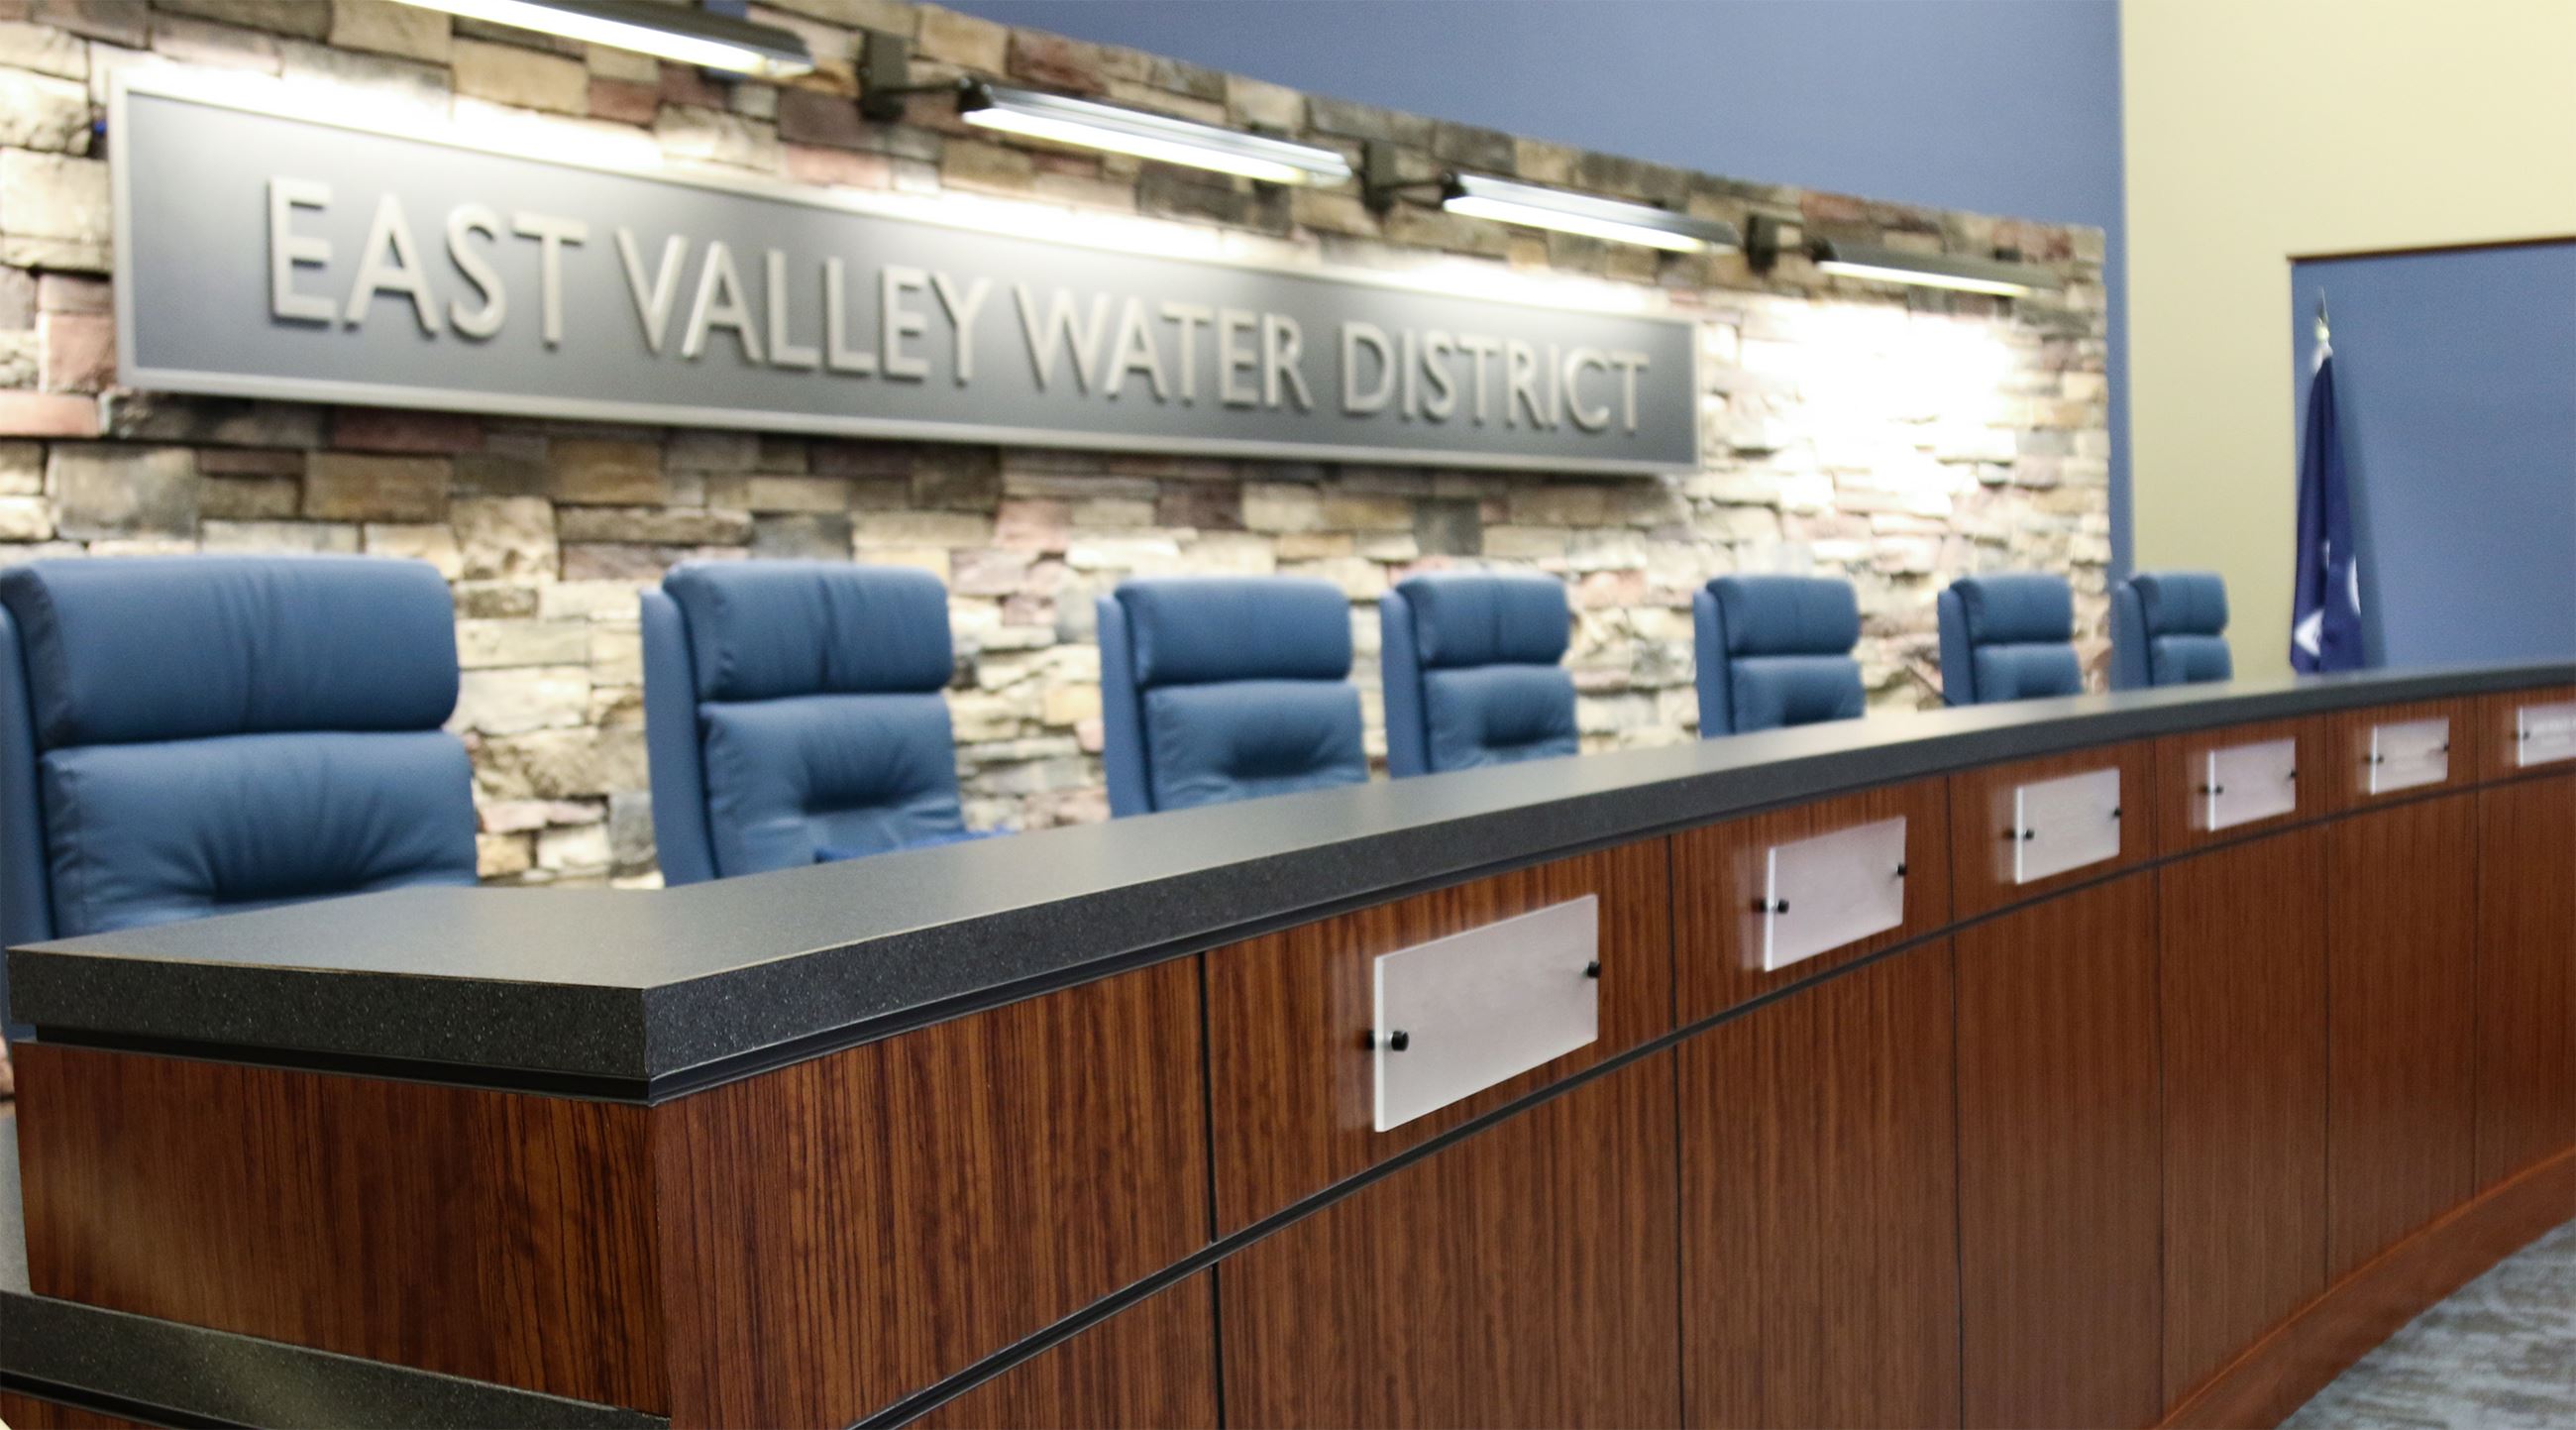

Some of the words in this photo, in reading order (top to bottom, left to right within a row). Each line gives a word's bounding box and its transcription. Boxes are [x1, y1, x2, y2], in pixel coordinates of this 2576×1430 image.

[268, 175, 588, 347] EAST
[614, 227, 993, 386] VALLEY
[1016, 282, 1314, 410] WATER
[1342, 321, 1650, 436] DISTRICT
